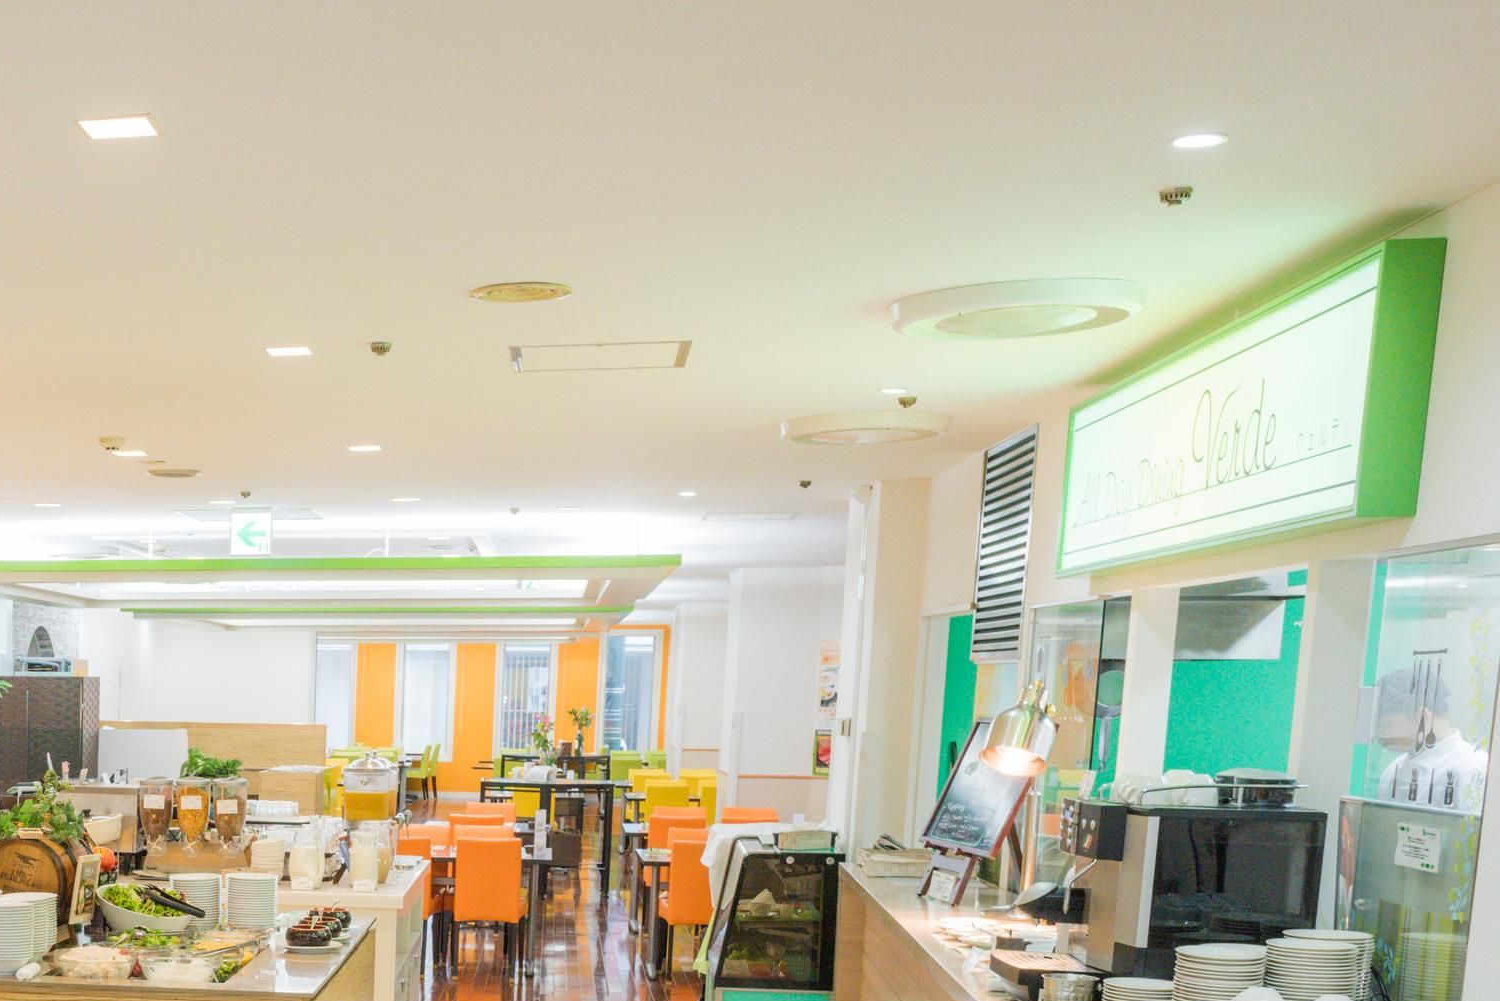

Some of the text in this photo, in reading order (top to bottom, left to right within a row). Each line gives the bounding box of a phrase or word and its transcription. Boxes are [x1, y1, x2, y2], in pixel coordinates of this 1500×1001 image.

[1104, 471, 1133, 531] Day
[1138, 458, 1186, 518] Dining
[1191, 377, 1278, 490] Verde
